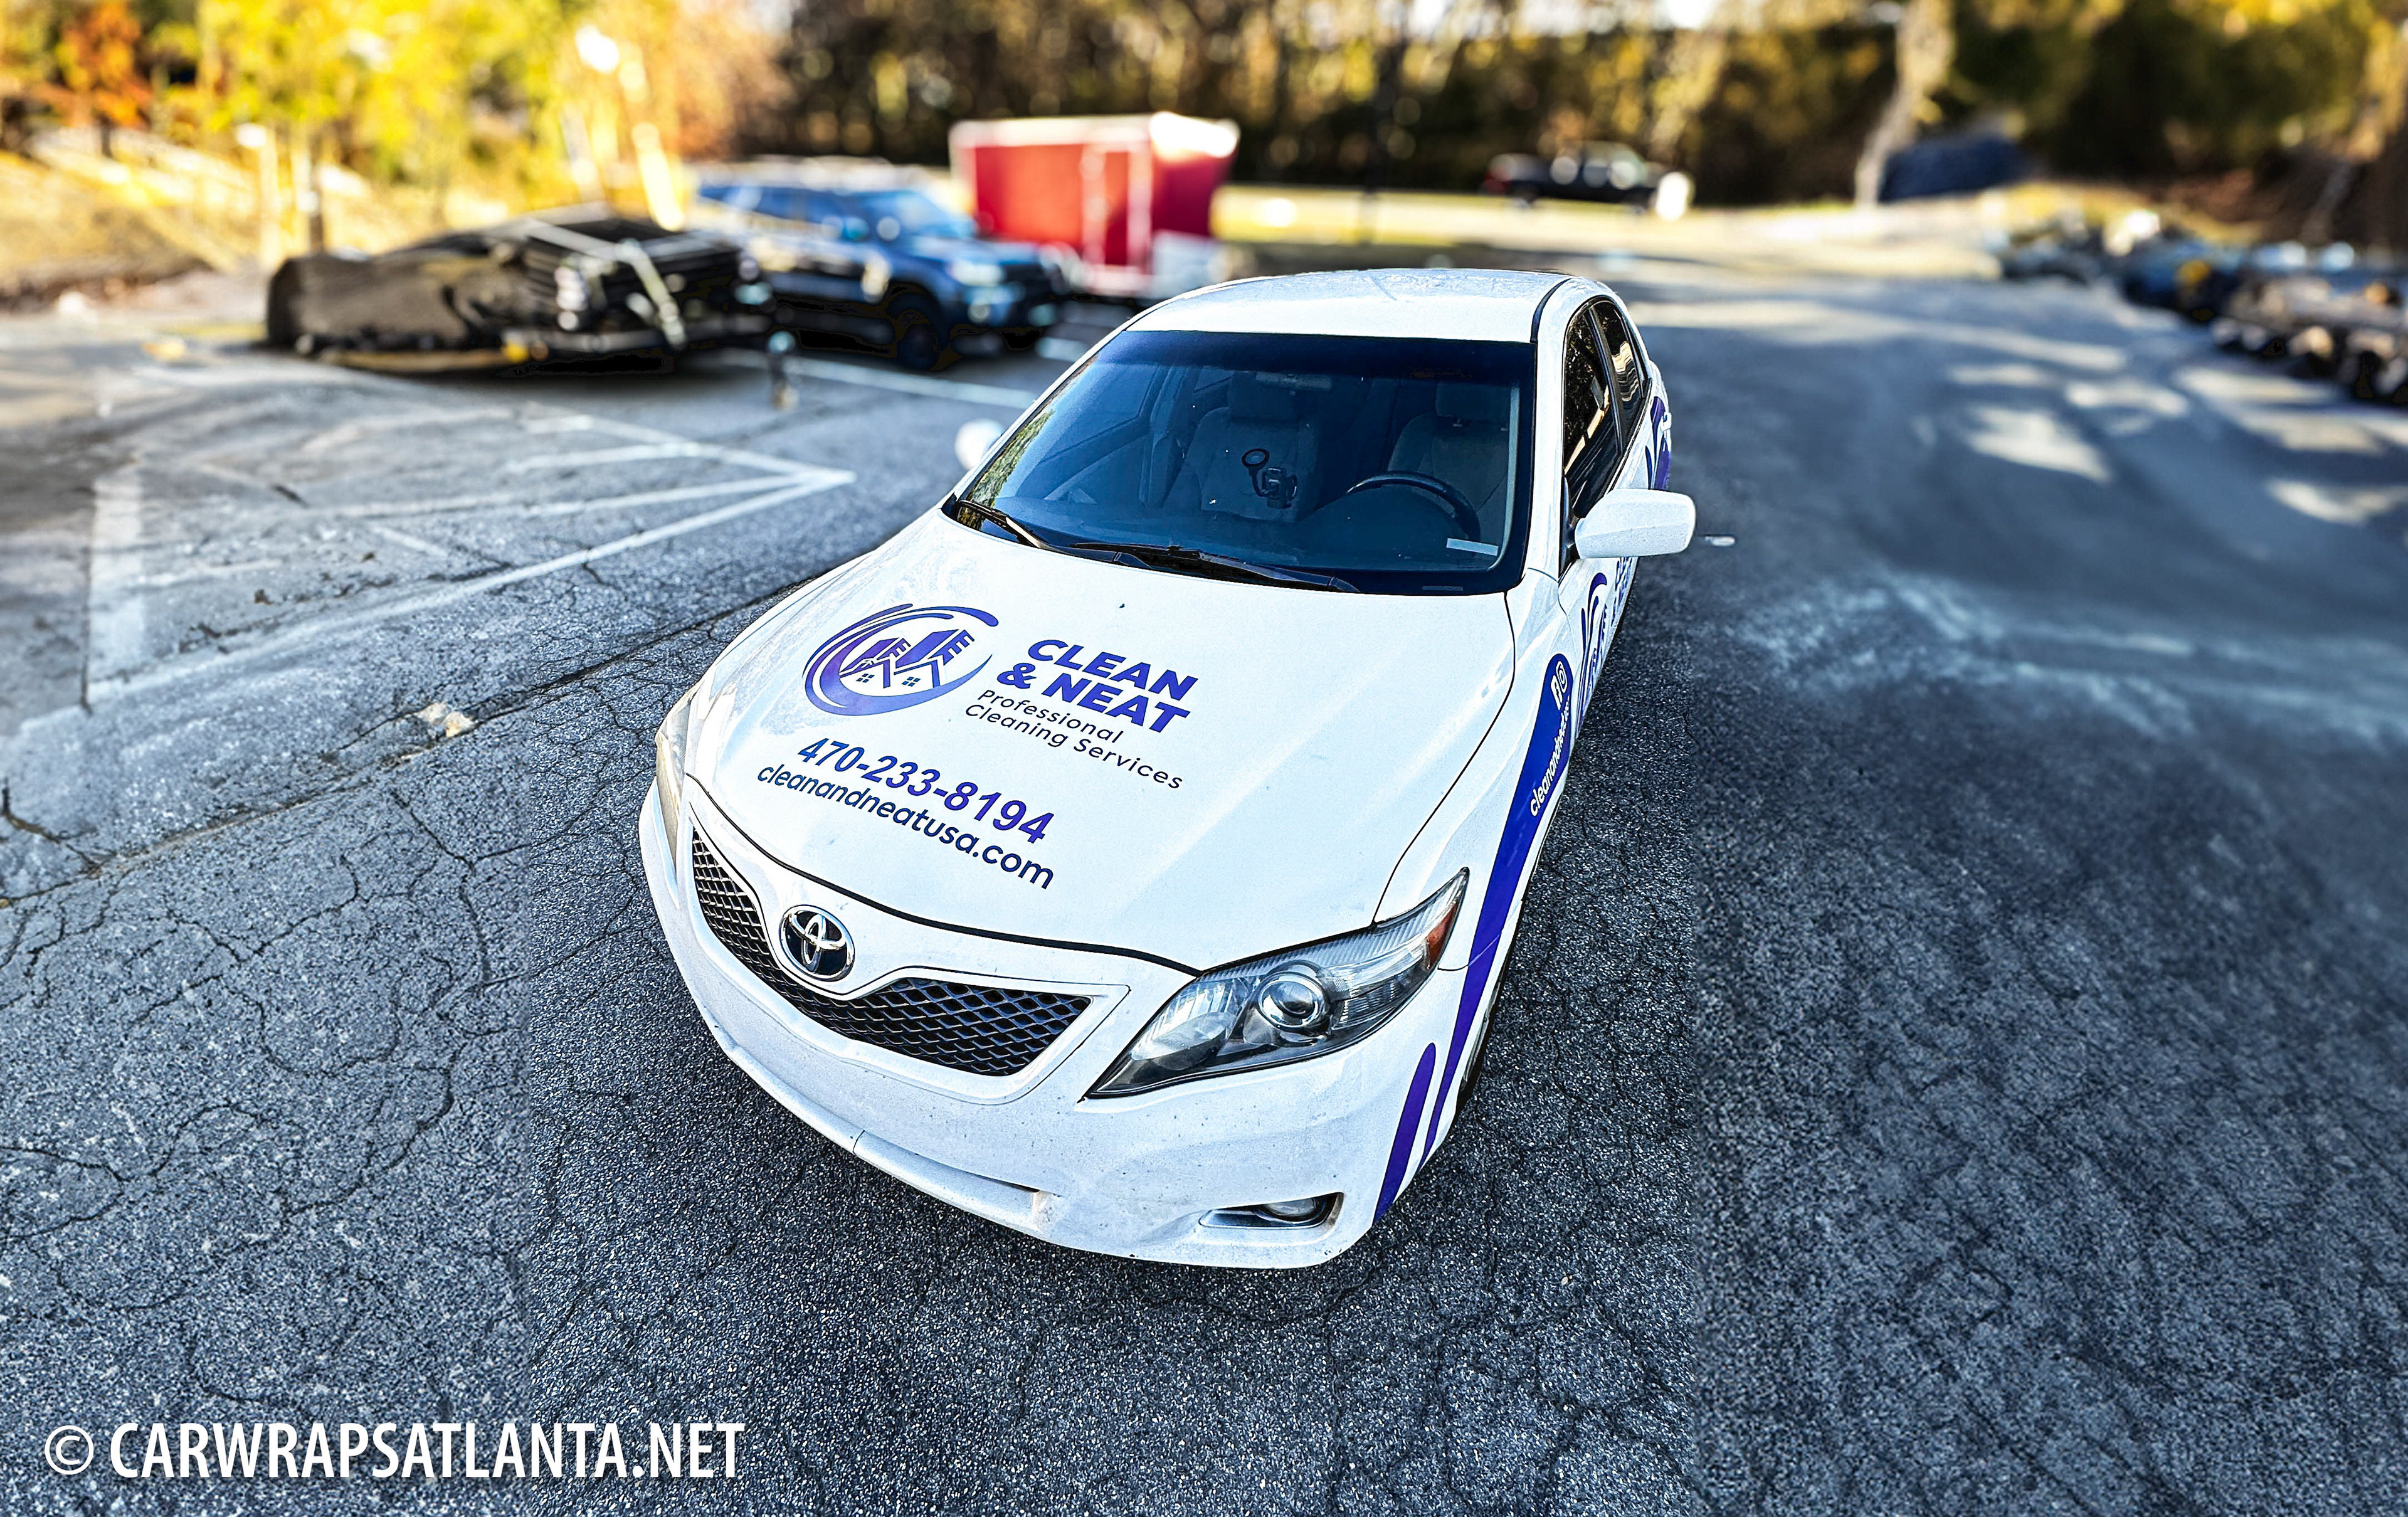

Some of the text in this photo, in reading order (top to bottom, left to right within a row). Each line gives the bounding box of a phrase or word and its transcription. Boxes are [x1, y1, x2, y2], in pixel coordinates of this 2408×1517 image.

[996, 662, 1191, 733] & NEAT
[1028, 639, 1199, 701] CLEAN
[965, 704, 1183, 789] Cleaning Services
[977, 689, 1124, 743] Professional
[757, 764, 1054, 890] cleanandneatusa.com
[797, 737, 1055, 844] 470-233-8194
